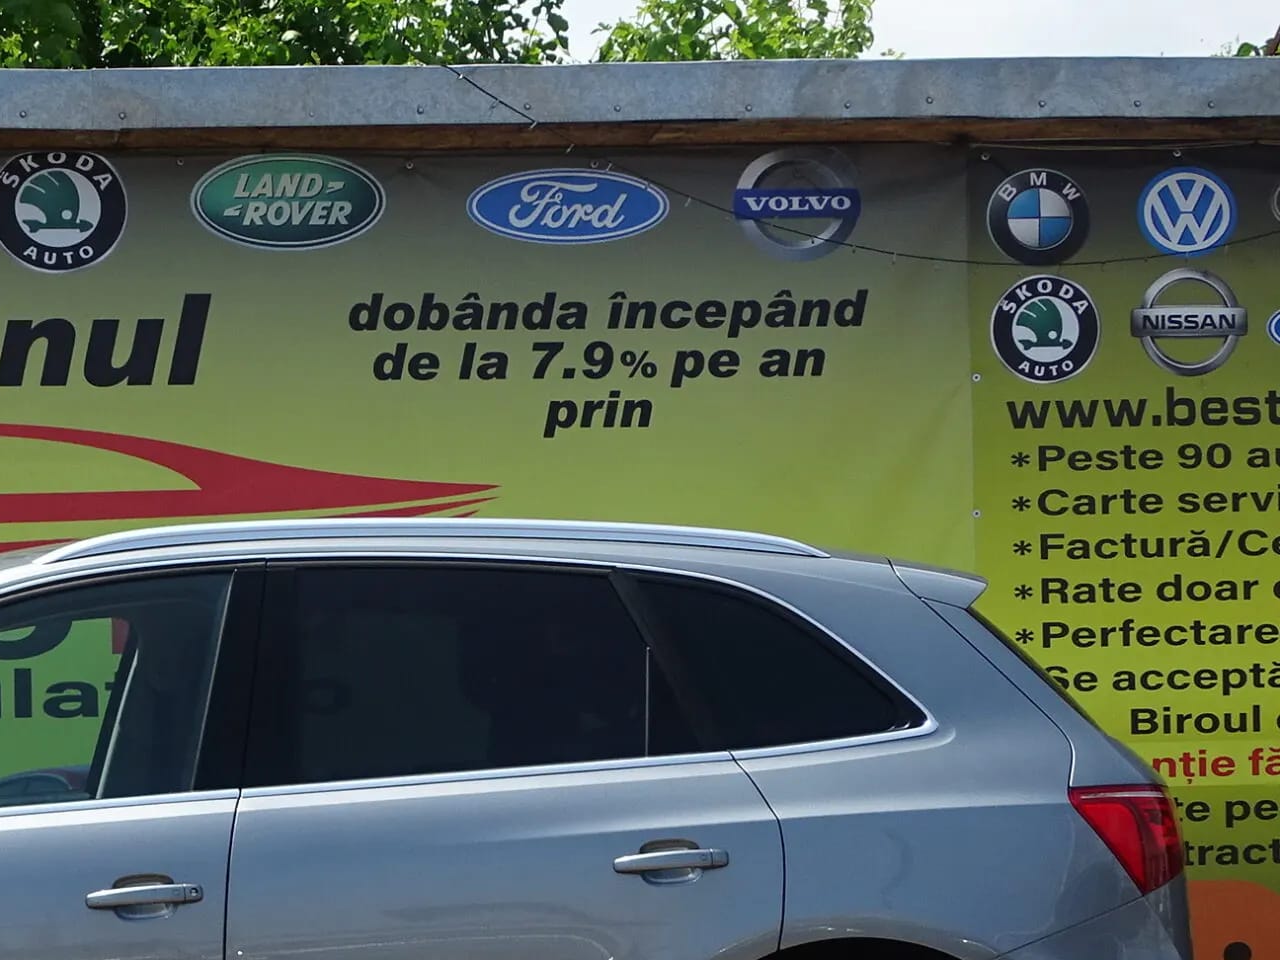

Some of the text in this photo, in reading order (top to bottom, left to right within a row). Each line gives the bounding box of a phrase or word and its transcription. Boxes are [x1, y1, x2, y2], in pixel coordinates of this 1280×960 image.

[233, 173, 324, 198] LAND
[998, 172, 1081, 203] BMW
[243, 201, 350, 225] ROVER
[509, 180, 628, 229] Ford
[743, 196, 852, 212] VOLVO
[23, 245, 94, 265] AUTO
[348, 288, 869, 339] dobânda începând
[1141, 313, 1237, 331] NISSAN
[373, 340, 827, 389] de la 7.9% pe an
[1018, 358, 1075, 377] AUTO
[543, 389, 654, 439] prin
[1177, 443, 1233, 470] 90
[1246, 446, 1280, 469] a
[1156, 574, 1259, 602] doar
[1130, 704, 1261, 736] Biroul
